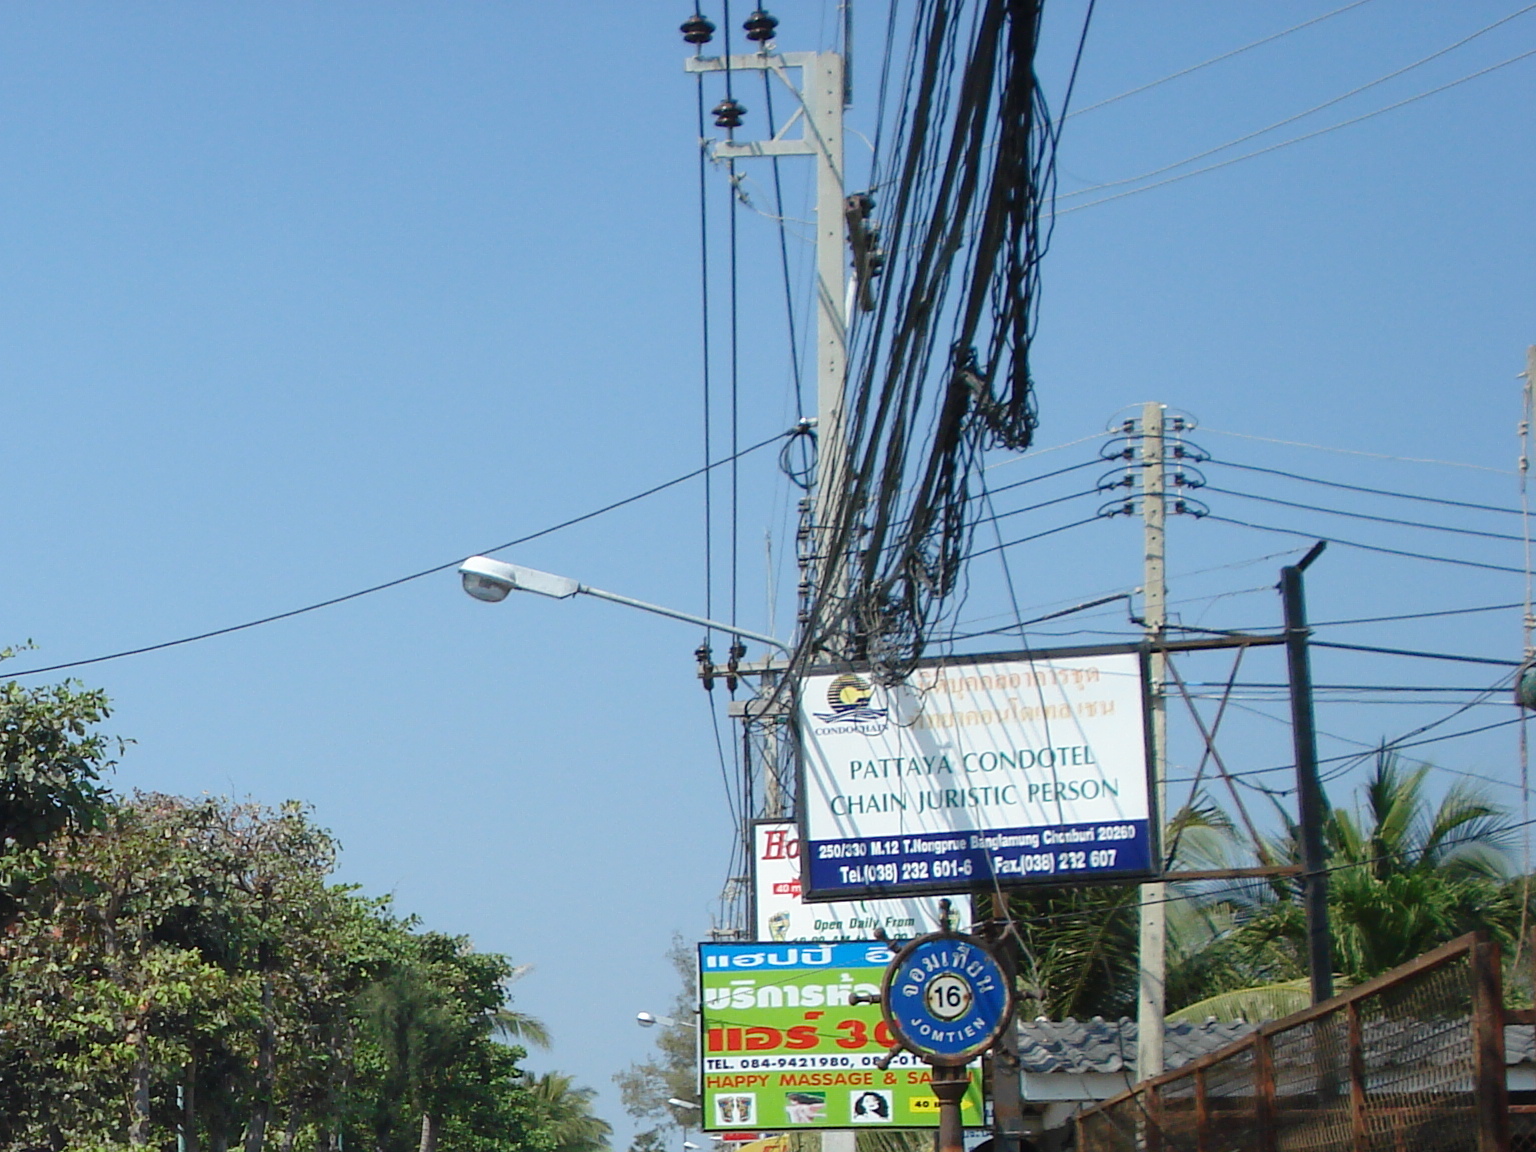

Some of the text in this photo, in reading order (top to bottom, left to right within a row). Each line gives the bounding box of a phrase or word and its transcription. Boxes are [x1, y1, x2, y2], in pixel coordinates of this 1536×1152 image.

[850, 745, 1096, 780] PATTAYA CONDOTEL
[830, 777, 1120, 816] CHAIN JURISTIC PERSON
[818, 842, 867, 859] 250/330
[870, 840, 900, 856] M.12
[969, 832, 1040, 851] Banglamung
[1042, 827, 1095, 845] Chonburi
[1097, 825, 1136, 841] 20260
[839, 849, 1117, 885] Tel.(038) 232 601-6 Fax.(038) 232 607
[813, 916, 915, 931] Open Daily From
[902, 942, 995, 997] จอมเทียน
[704, 973, 882, 1010] บริการห้อ
[934, 986, 961, 1008] 16
[707, 1011, 825, 1052] แอร์
[911, 1017, 986, 1043] JOMTIEN
[707, 1059, 734, 1070] TEL.
[740, 1056, 855, 1068] 084-9421980,
[706, 1075, 770, 1089] HAPPY
[779, 1073, 873, 1087] MASSAGE
[882, 1072, 897, 1085] &
